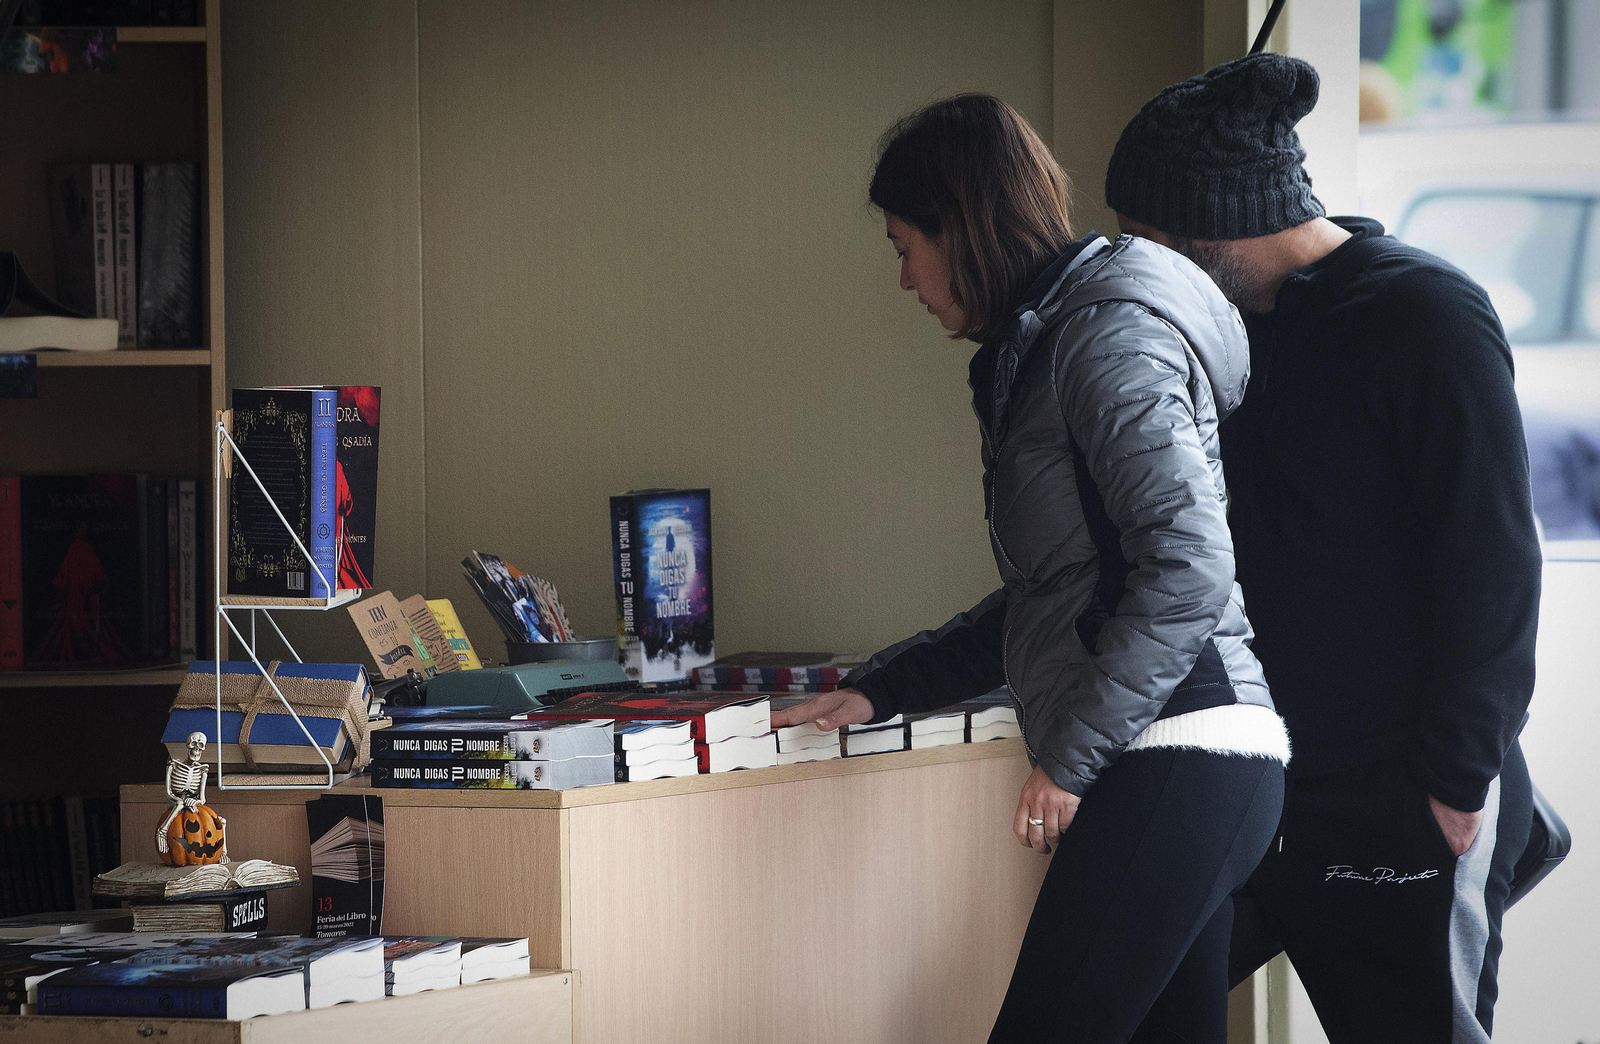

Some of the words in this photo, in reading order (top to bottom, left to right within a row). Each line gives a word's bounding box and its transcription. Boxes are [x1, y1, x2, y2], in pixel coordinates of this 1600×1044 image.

[318, 398, 331, 417] II
[619, 520, 630, 549] NUNCA
[620, 552, 632, 578] DIGAS
[656, 550, 687, 568] NUNCA
[660, 569, 685, 585] DIGAS
[620, 581, 634, 594] TU
[668, 585, 680, 599] TU
[367, 604, 388, 623] TEN
[623, 597, 635, 632] NOMBRE
[656, 599, 692, 618] NOMBRE
[368, 620, 399, 640] CONFIANZA
[393, 739, 421, 751] NUNCA
[424, 739, 448, 751] DIGAS
[451, 738, 464, 753] TU
[466, 740, 500, 752] NOMBRE
[393, 767, 421, 779] NUNCA
[424, 768, 449, 780] DIGAS
[451, 766, 465, 781] TU
[467, 768, 501, 780] NOMBRE
[232, 897, 265, 928] SPELLS
[318, 896, 333, 912] 13
[317, 915, 336, 924] Feria
[336, 914, 346, 922] del
[346, 912, 367, 921] Libro
[316, 930, 347, 939] Tomares
